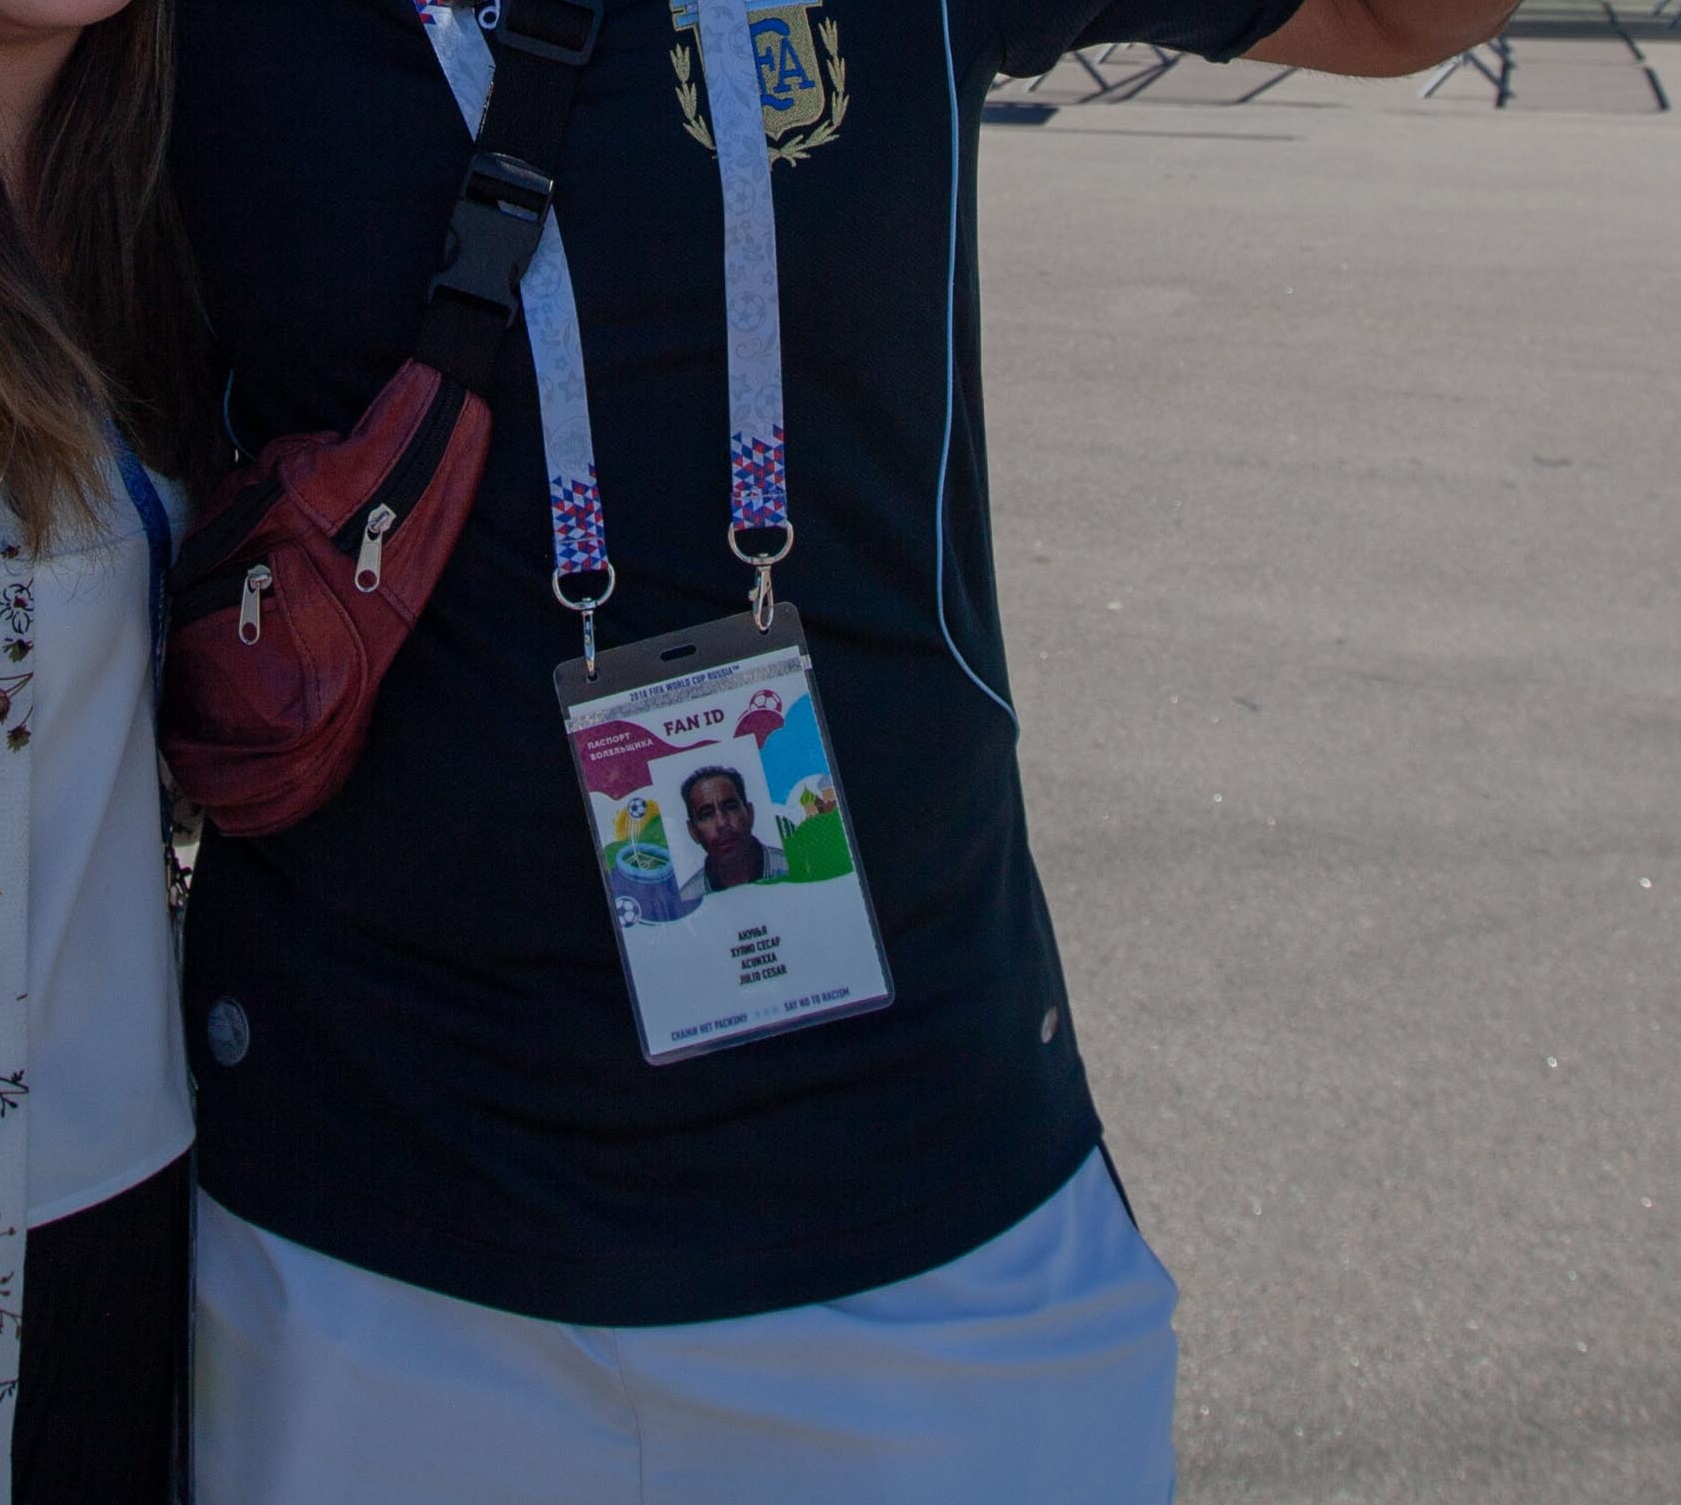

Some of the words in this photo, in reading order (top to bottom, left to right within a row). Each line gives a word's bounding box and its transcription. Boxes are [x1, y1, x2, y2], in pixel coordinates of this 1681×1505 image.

[649, 685, 668, 698] FIFA
[667, 678, 692, 692] WORLD
[691, 673, 707, 687] CUP
[662, 714, 702, 736] FAN
[705, 708, 725, 724] ID
[587, 732, 631, 750] ПАСПОРТ
[783, 998, 798, 1012] SAY
